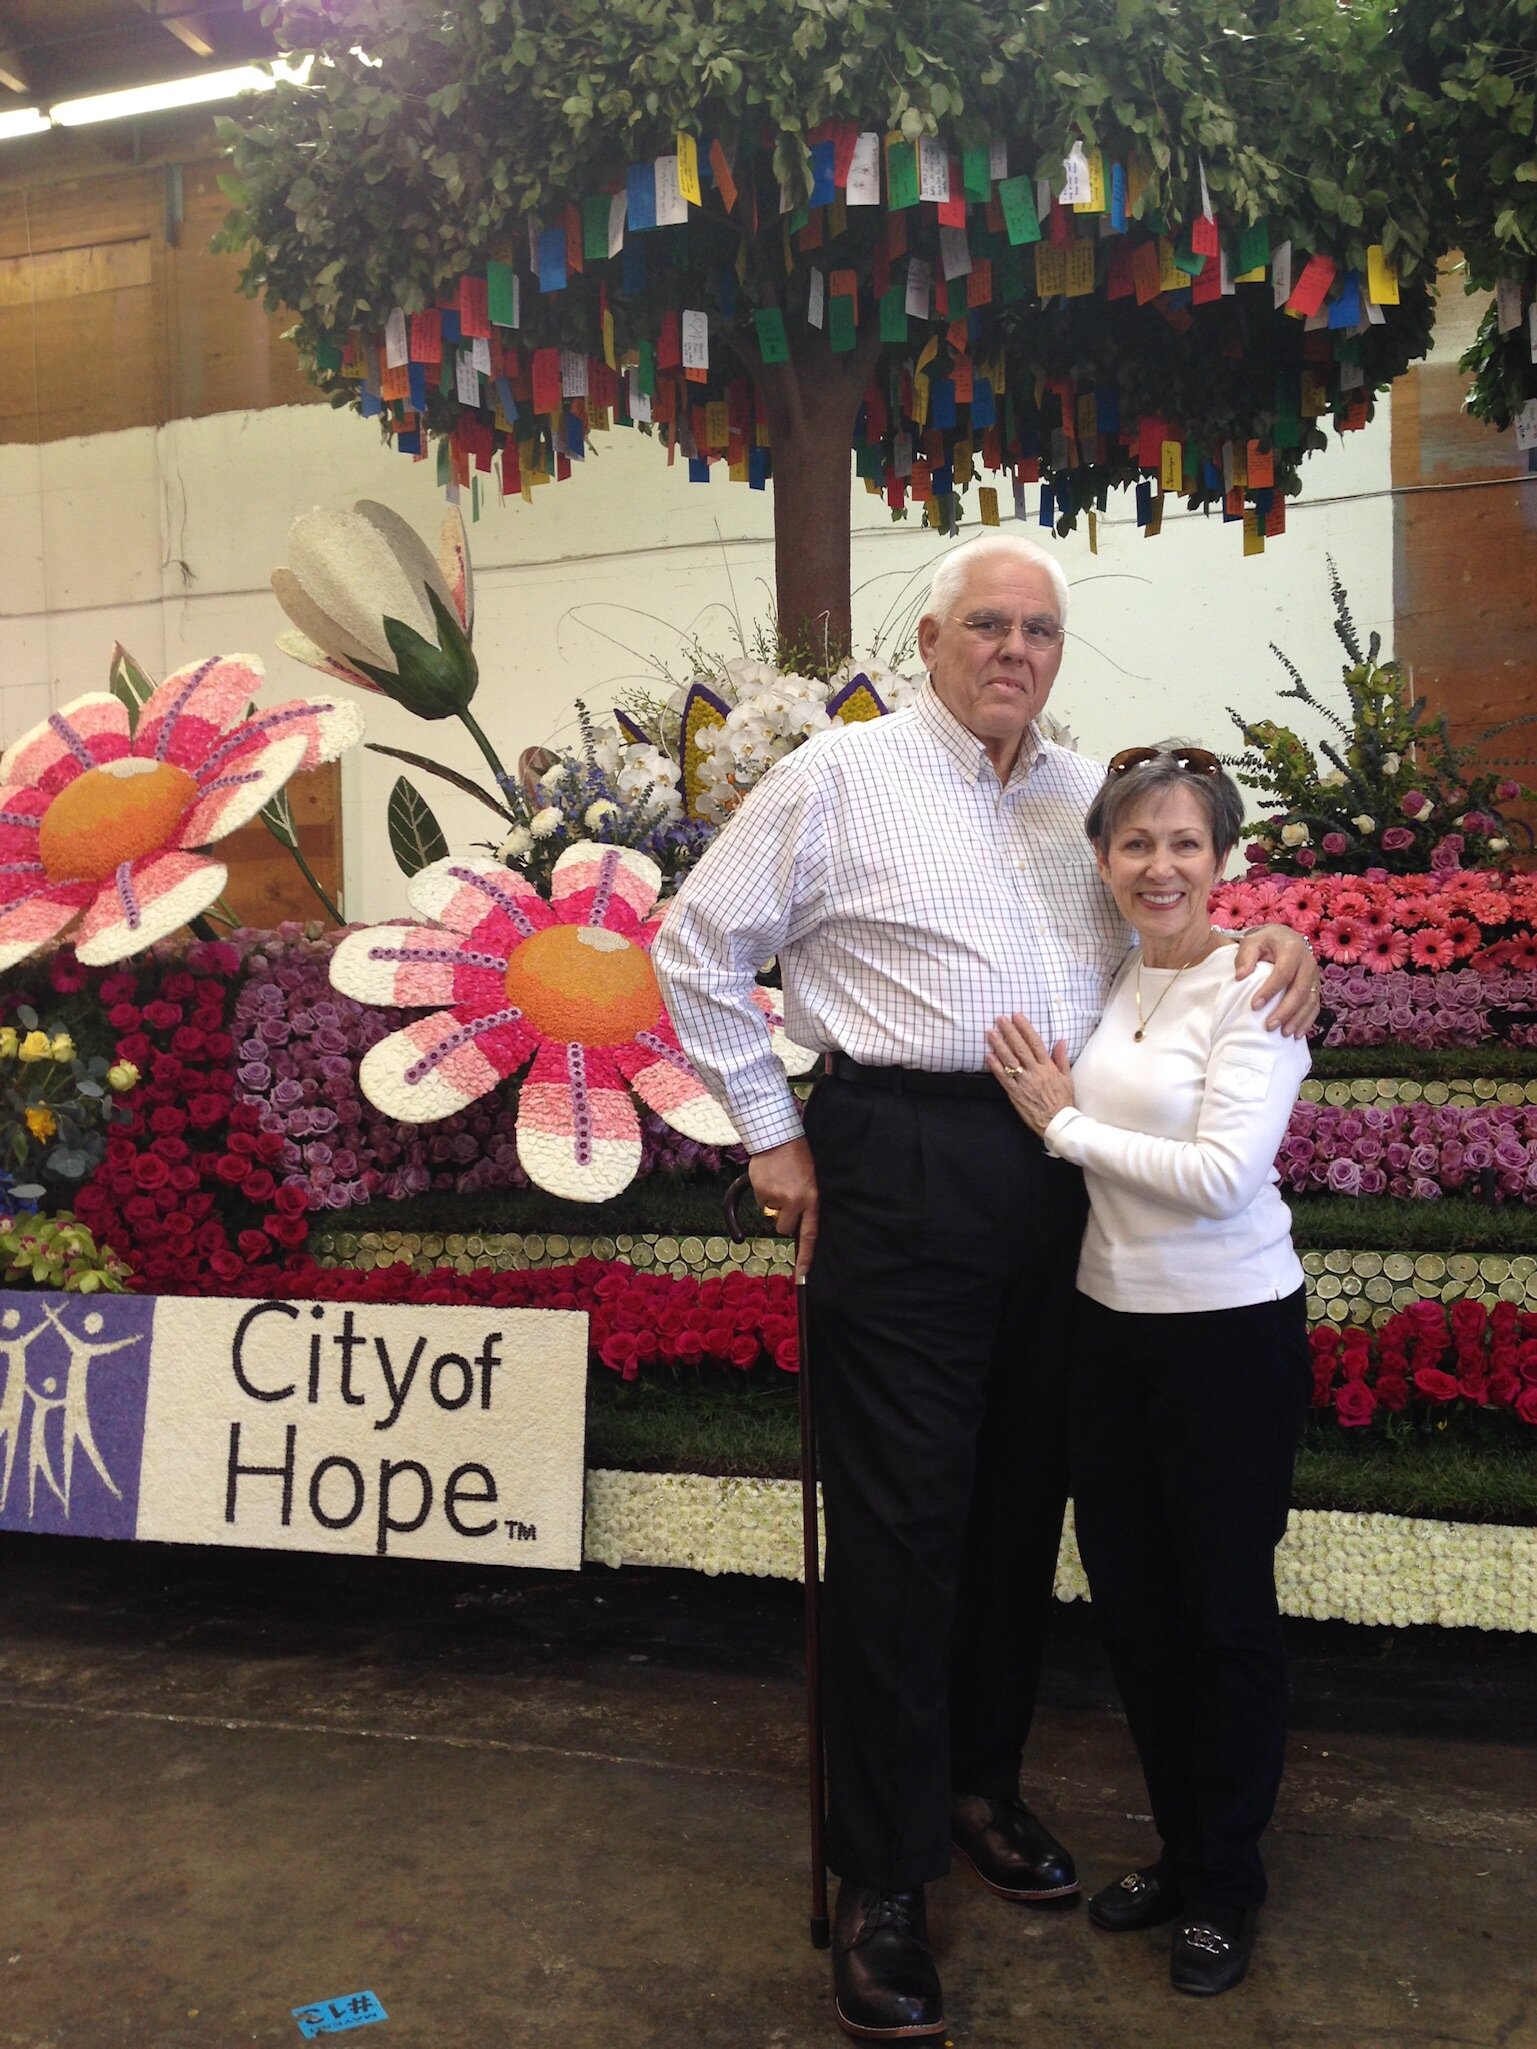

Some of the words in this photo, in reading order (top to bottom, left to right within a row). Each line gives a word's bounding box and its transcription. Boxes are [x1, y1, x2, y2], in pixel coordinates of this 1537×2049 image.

[232, 1300, 427, 1430] City
[429, 1332, 503, 1410] of
[225, 1422, 498, 1554] Hope
